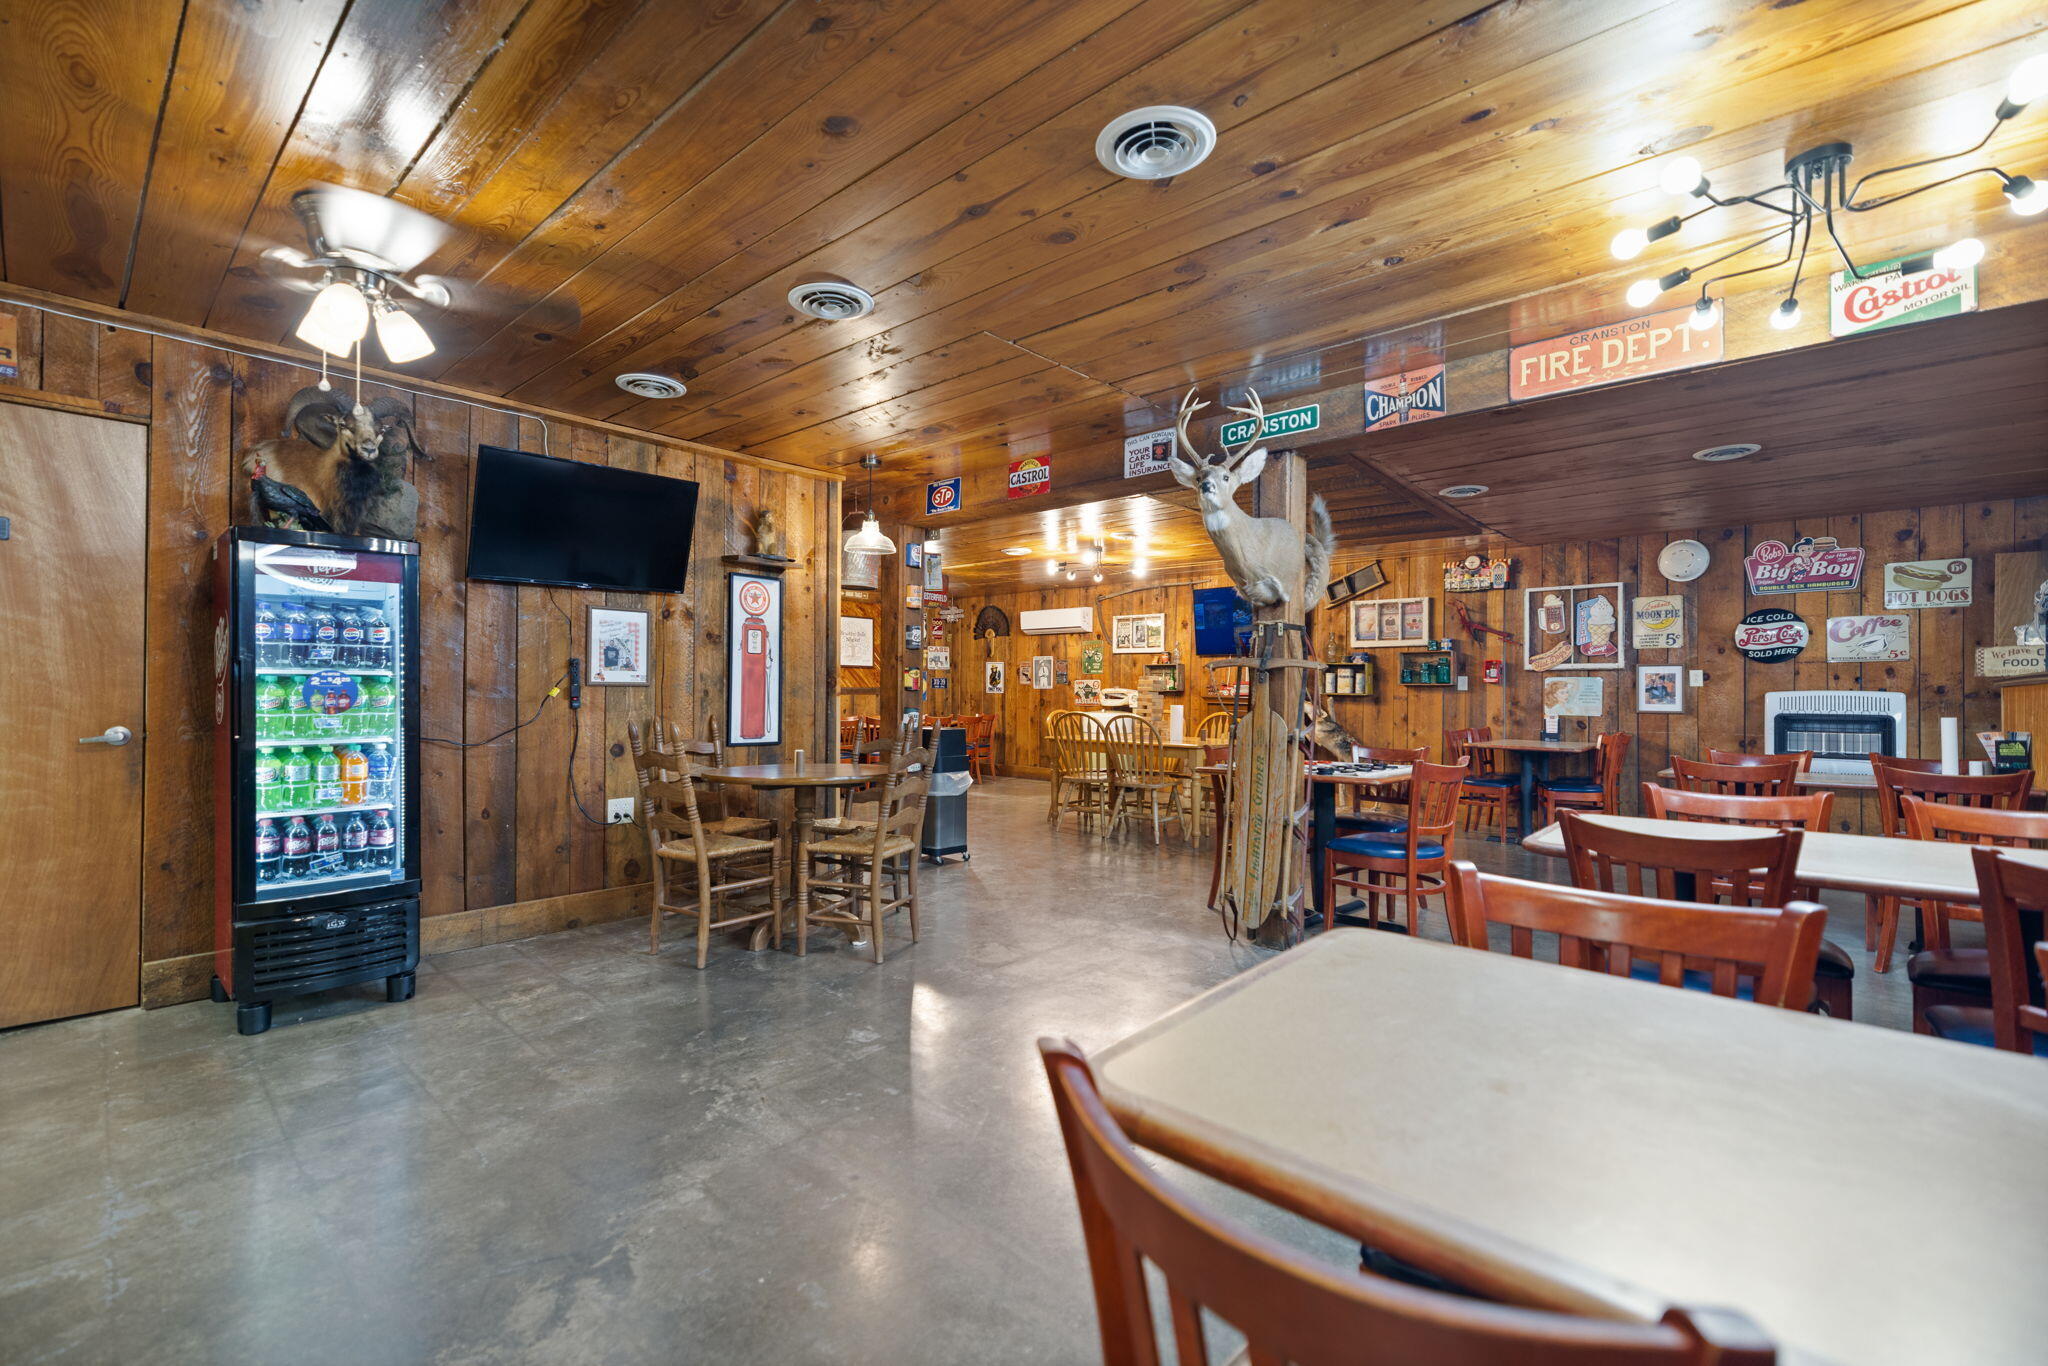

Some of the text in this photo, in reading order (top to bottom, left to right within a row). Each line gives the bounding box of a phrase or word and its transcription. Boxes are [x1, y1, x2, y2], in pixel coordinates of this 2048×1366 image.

[1844, 267, 1962, 323] Castrol
[1904, 283, 1971, 312] MOTOR OIL
[1569, 320, 1651, 346] CRANSTON
[1520, 323, 1710, 387] FIRE DEPT.
[1366, 376, 1442, 421] CHAMPION
[1227, 411, 1312, 442] CRANSTON
[1379, 412, 1431, 428] SPARK PLUGS
[1127, 439, 1138, 447] THIS
[1152, 431, 1175, 439] CONTAINS
[1128, 446, 1150, 457] YOUR
[1128, 462, 1171, 477] INSURANCE
[1129, 461, 1145, 470] LIFE
[1010, 467, 1049, 486] CASTROL
[934, 488, 952, 504] STP
[1760, 546, 1782, 561] Bob's
[1755, 560, 1856, 581] Big Boy
[1807, 580, 1850, 588] HAMBURGER
[923, 592, 948, 602] ESTERFIELD
[1887, 588, 1970, 604] HOT DOGS
[1636, 609, 1681, 620] MOON PIE
[1746, 612, 1794, 624] ICE COLD
[1829, 616, 1904, 643] Coffee
[1748, 647, 1799, 658] SOLD HERE
[1991, 649, 2006, 659] We
[2008, 646, 2031, 657] Have
[2002, 658, 2040, 667] FOOD
